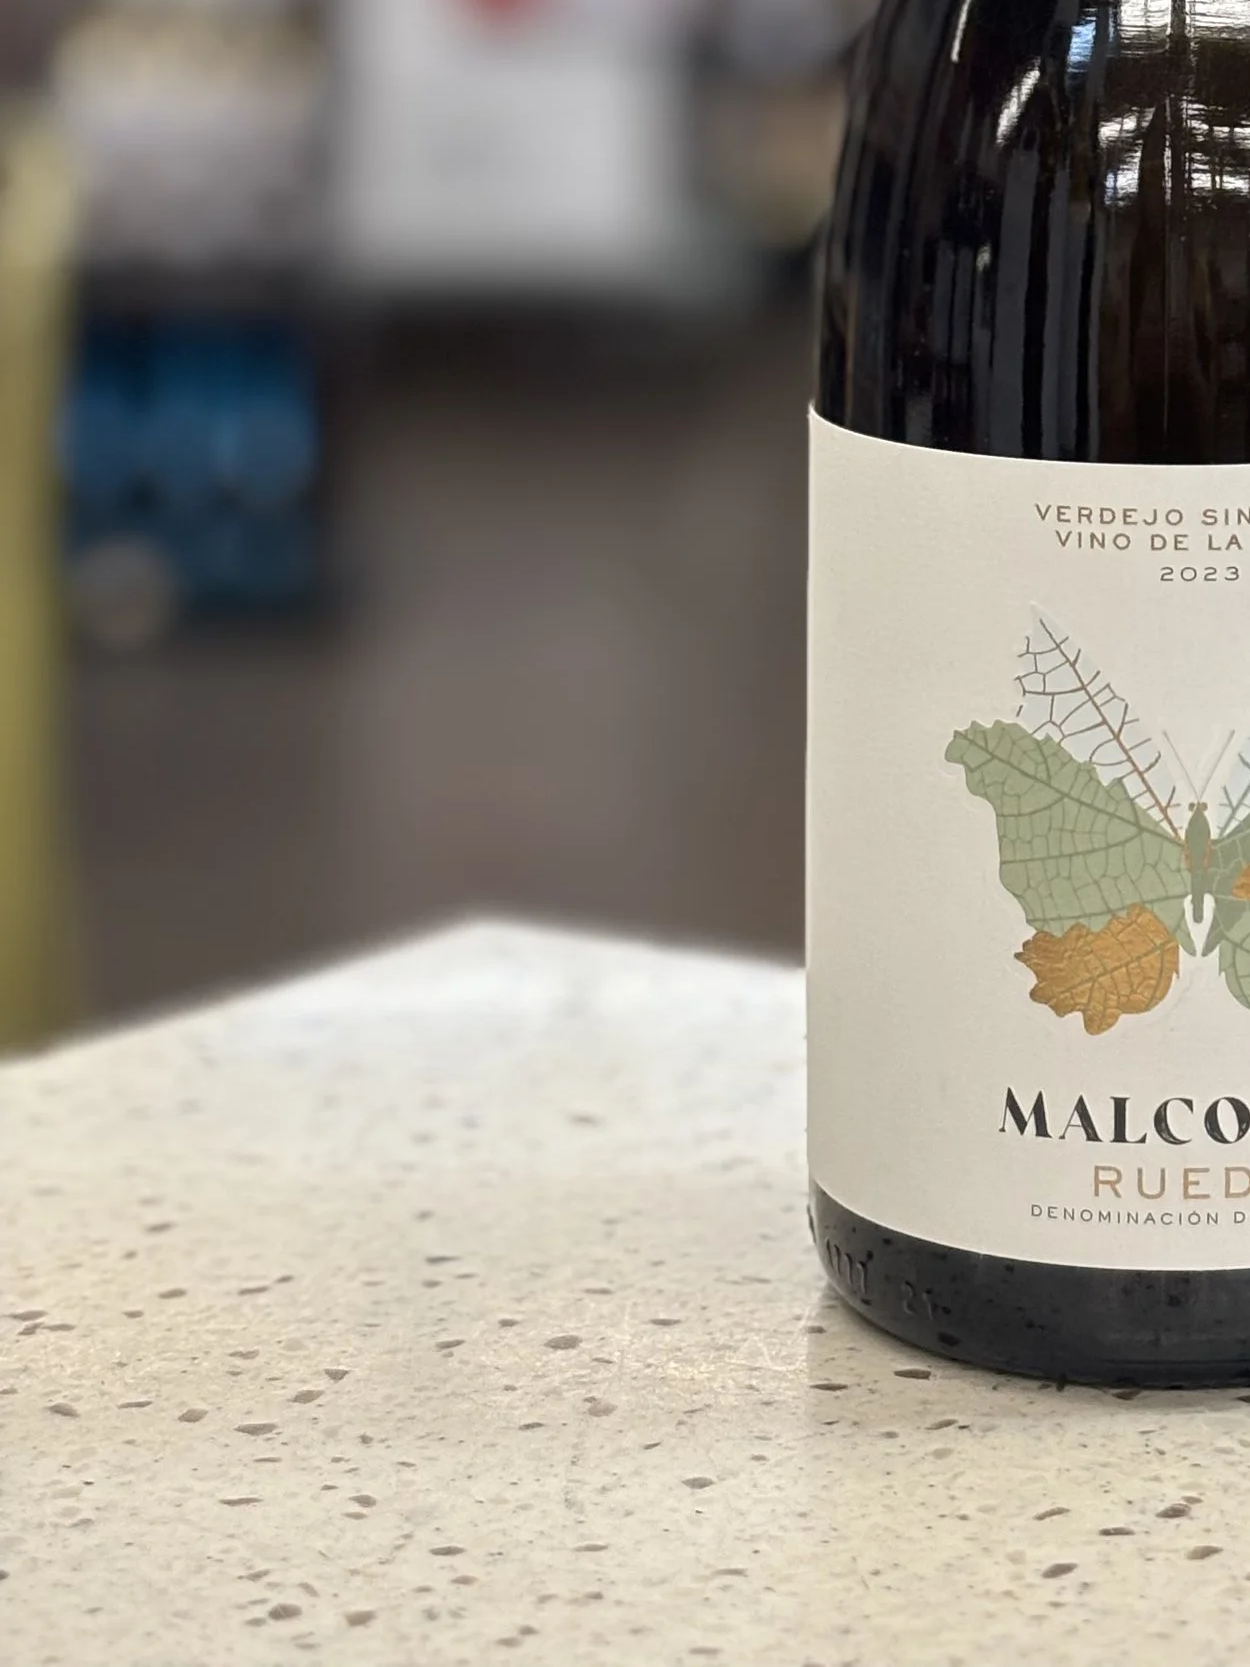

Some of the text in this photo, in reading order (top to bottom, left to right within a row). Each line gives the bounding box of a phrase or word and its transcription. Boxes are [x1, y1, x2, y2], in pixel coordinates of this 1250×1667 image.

[1035, 503, 1184, 526] VERDEJO
[1055, 530, 1132, 551] VINO
[1150, 534, 1189, 551] DE
[1207, 533, 1243, 551] LA
[1159, 566, 1241, 582] 2023
